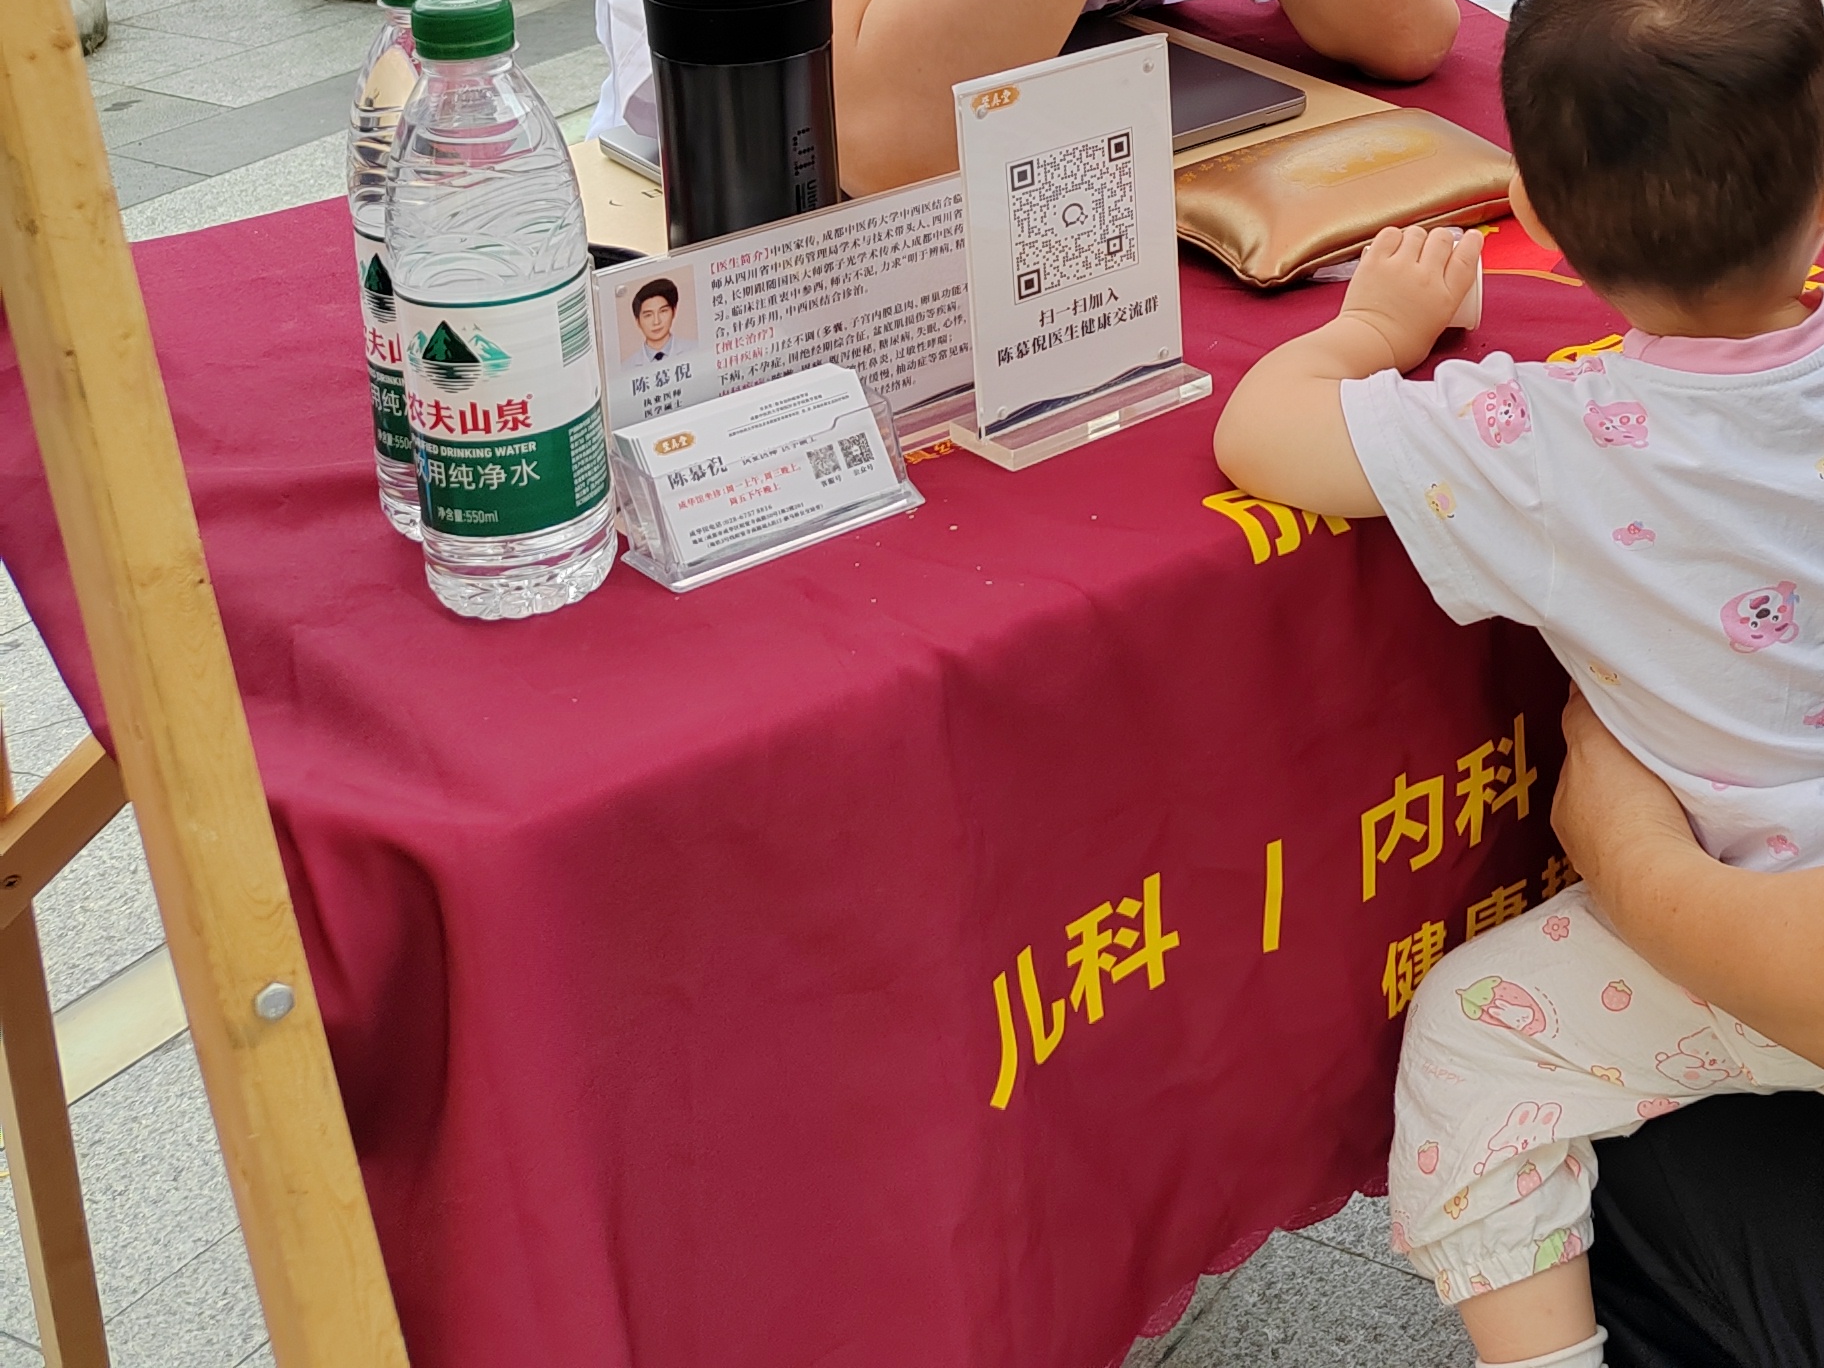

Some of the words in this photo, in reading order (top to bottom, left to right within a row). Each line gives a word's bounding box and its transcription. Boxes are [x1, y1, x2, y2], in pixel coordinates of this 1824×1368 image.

[1038, 287, 1120, 329] 扫一扫加入
[408, 391, 534, 435] 农夫山泉
[440, 443, 493, 459] DRINKING
[495, 440, 537, 457] WATER
[416, 453, 541, 490] 饮用纯净水
[990, 872, 1180, 1111] 儿科
[1359, 712, 1539, 903] 内科
